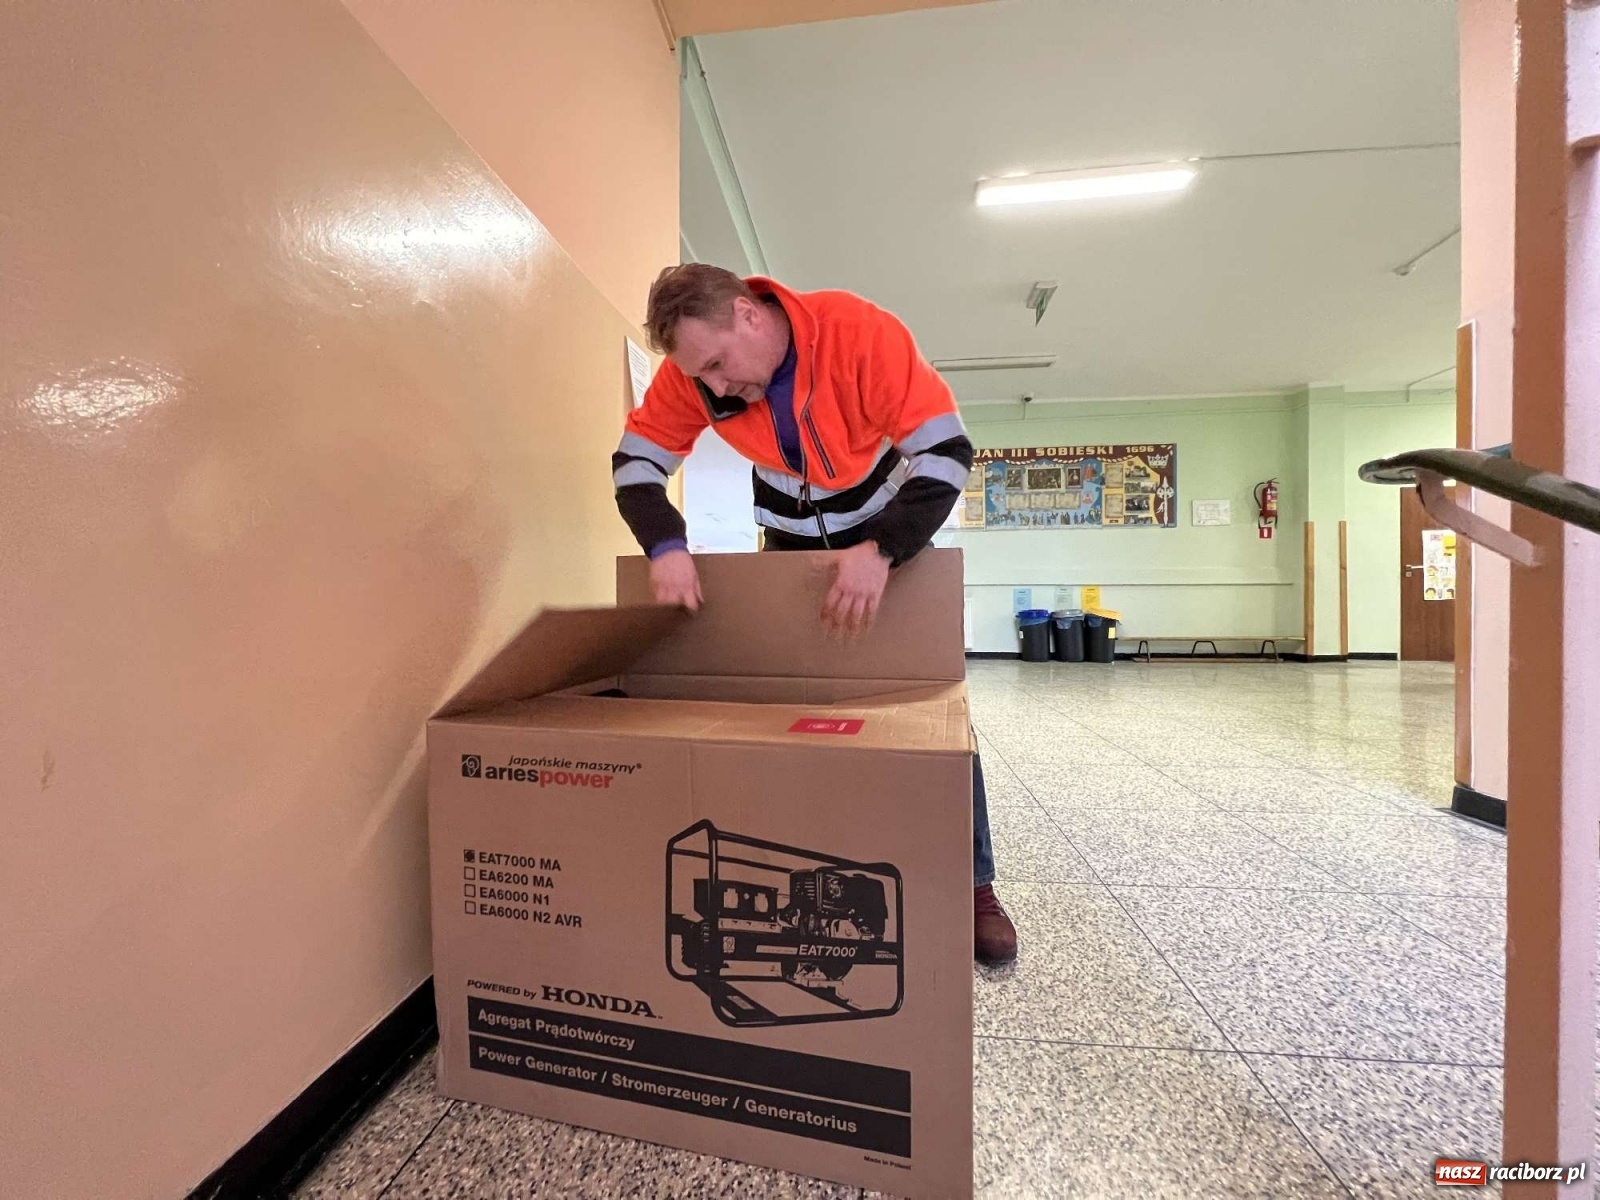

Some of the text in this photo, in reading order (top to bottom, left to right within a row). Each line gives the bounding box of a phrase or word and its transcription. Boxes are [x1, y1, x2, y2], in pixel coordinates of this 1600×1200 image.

[973, 445, 1154, 458] JAN III SOBIESKI 1696
[508, 755, 572, 769] japońskie
[479, 851, 561, 871] EAT7000 MA
[480, 869, 554, 889] EA6200 MA
[480, 887, 550, 906] EA6000 N1
[480, 904, 582, 928] EA6000 N2 AVR
[467, 979, 657, 1019] POWERED by HONDA
[478, 1008, 635, 1051] Agregat Prądotwórczy
[478, 1046, 521, 1066] Power
[525, 1056, 597, 1081] Generator
[612, 1074, 728, 1107] Stromerzeuger
[745, 1099, 857, 1133] Generatorius
